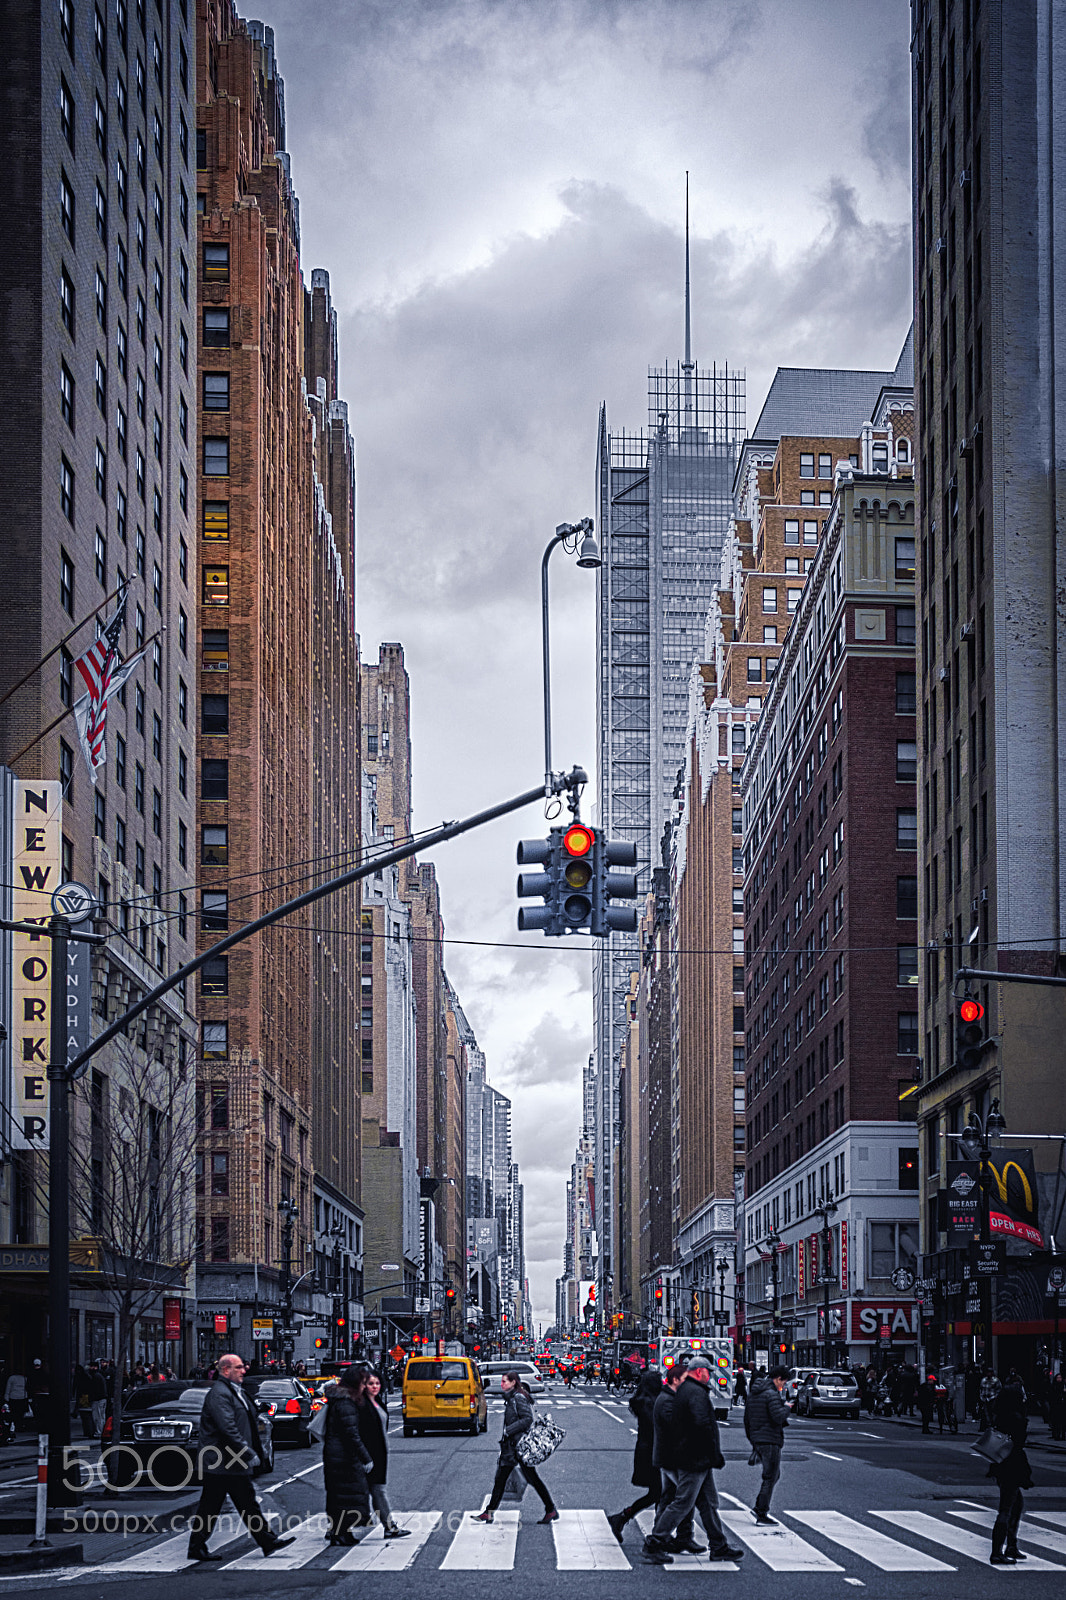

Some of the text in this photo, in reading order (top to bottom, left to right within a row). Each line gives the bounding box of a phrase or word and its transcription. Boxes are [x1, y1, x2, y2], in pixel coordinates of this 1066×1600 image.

[20, 788, 51, 1138] NEW YORKER
[478, 1237, 492, 1245] SoFi
[991, 1217, 1015, 1231] OPEN
[1026, 1228, 1041, 1242] HRS
